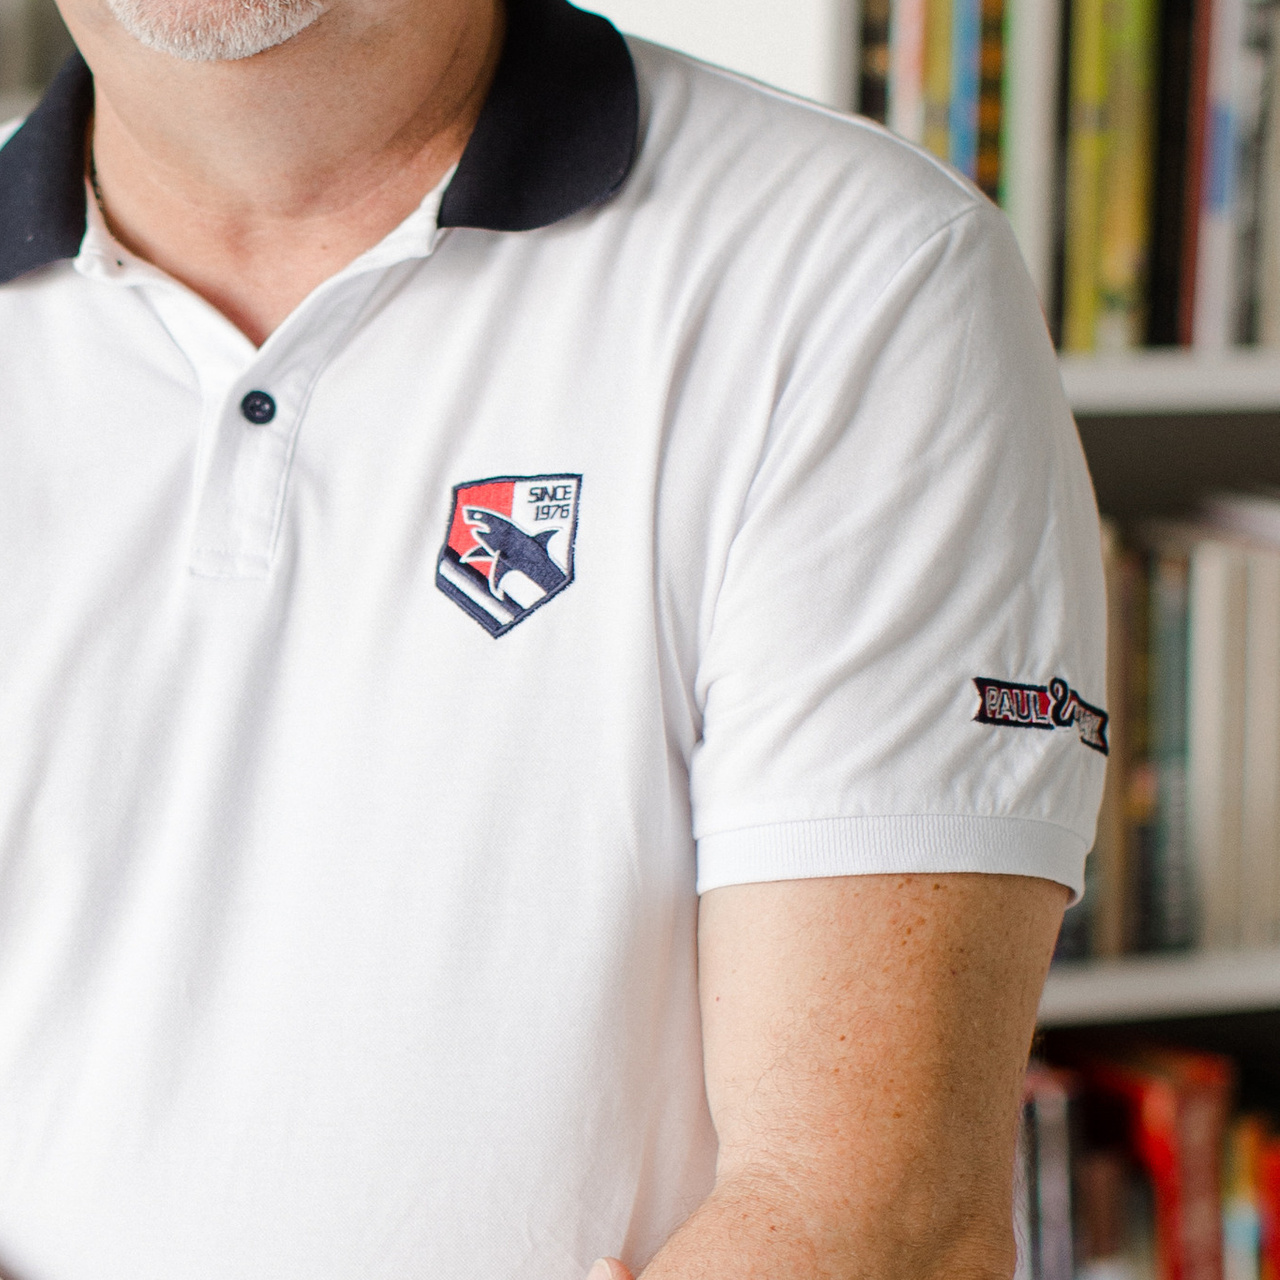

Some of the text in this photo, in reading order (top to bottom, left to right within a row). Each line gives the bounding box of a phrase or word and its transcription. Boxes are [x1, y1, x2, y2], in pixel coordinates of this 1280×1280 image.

[529, 486, 572, 503] SINCE
[535, 504, 570, 521] 1976
[986, 687, 1049, 723] PAUL
